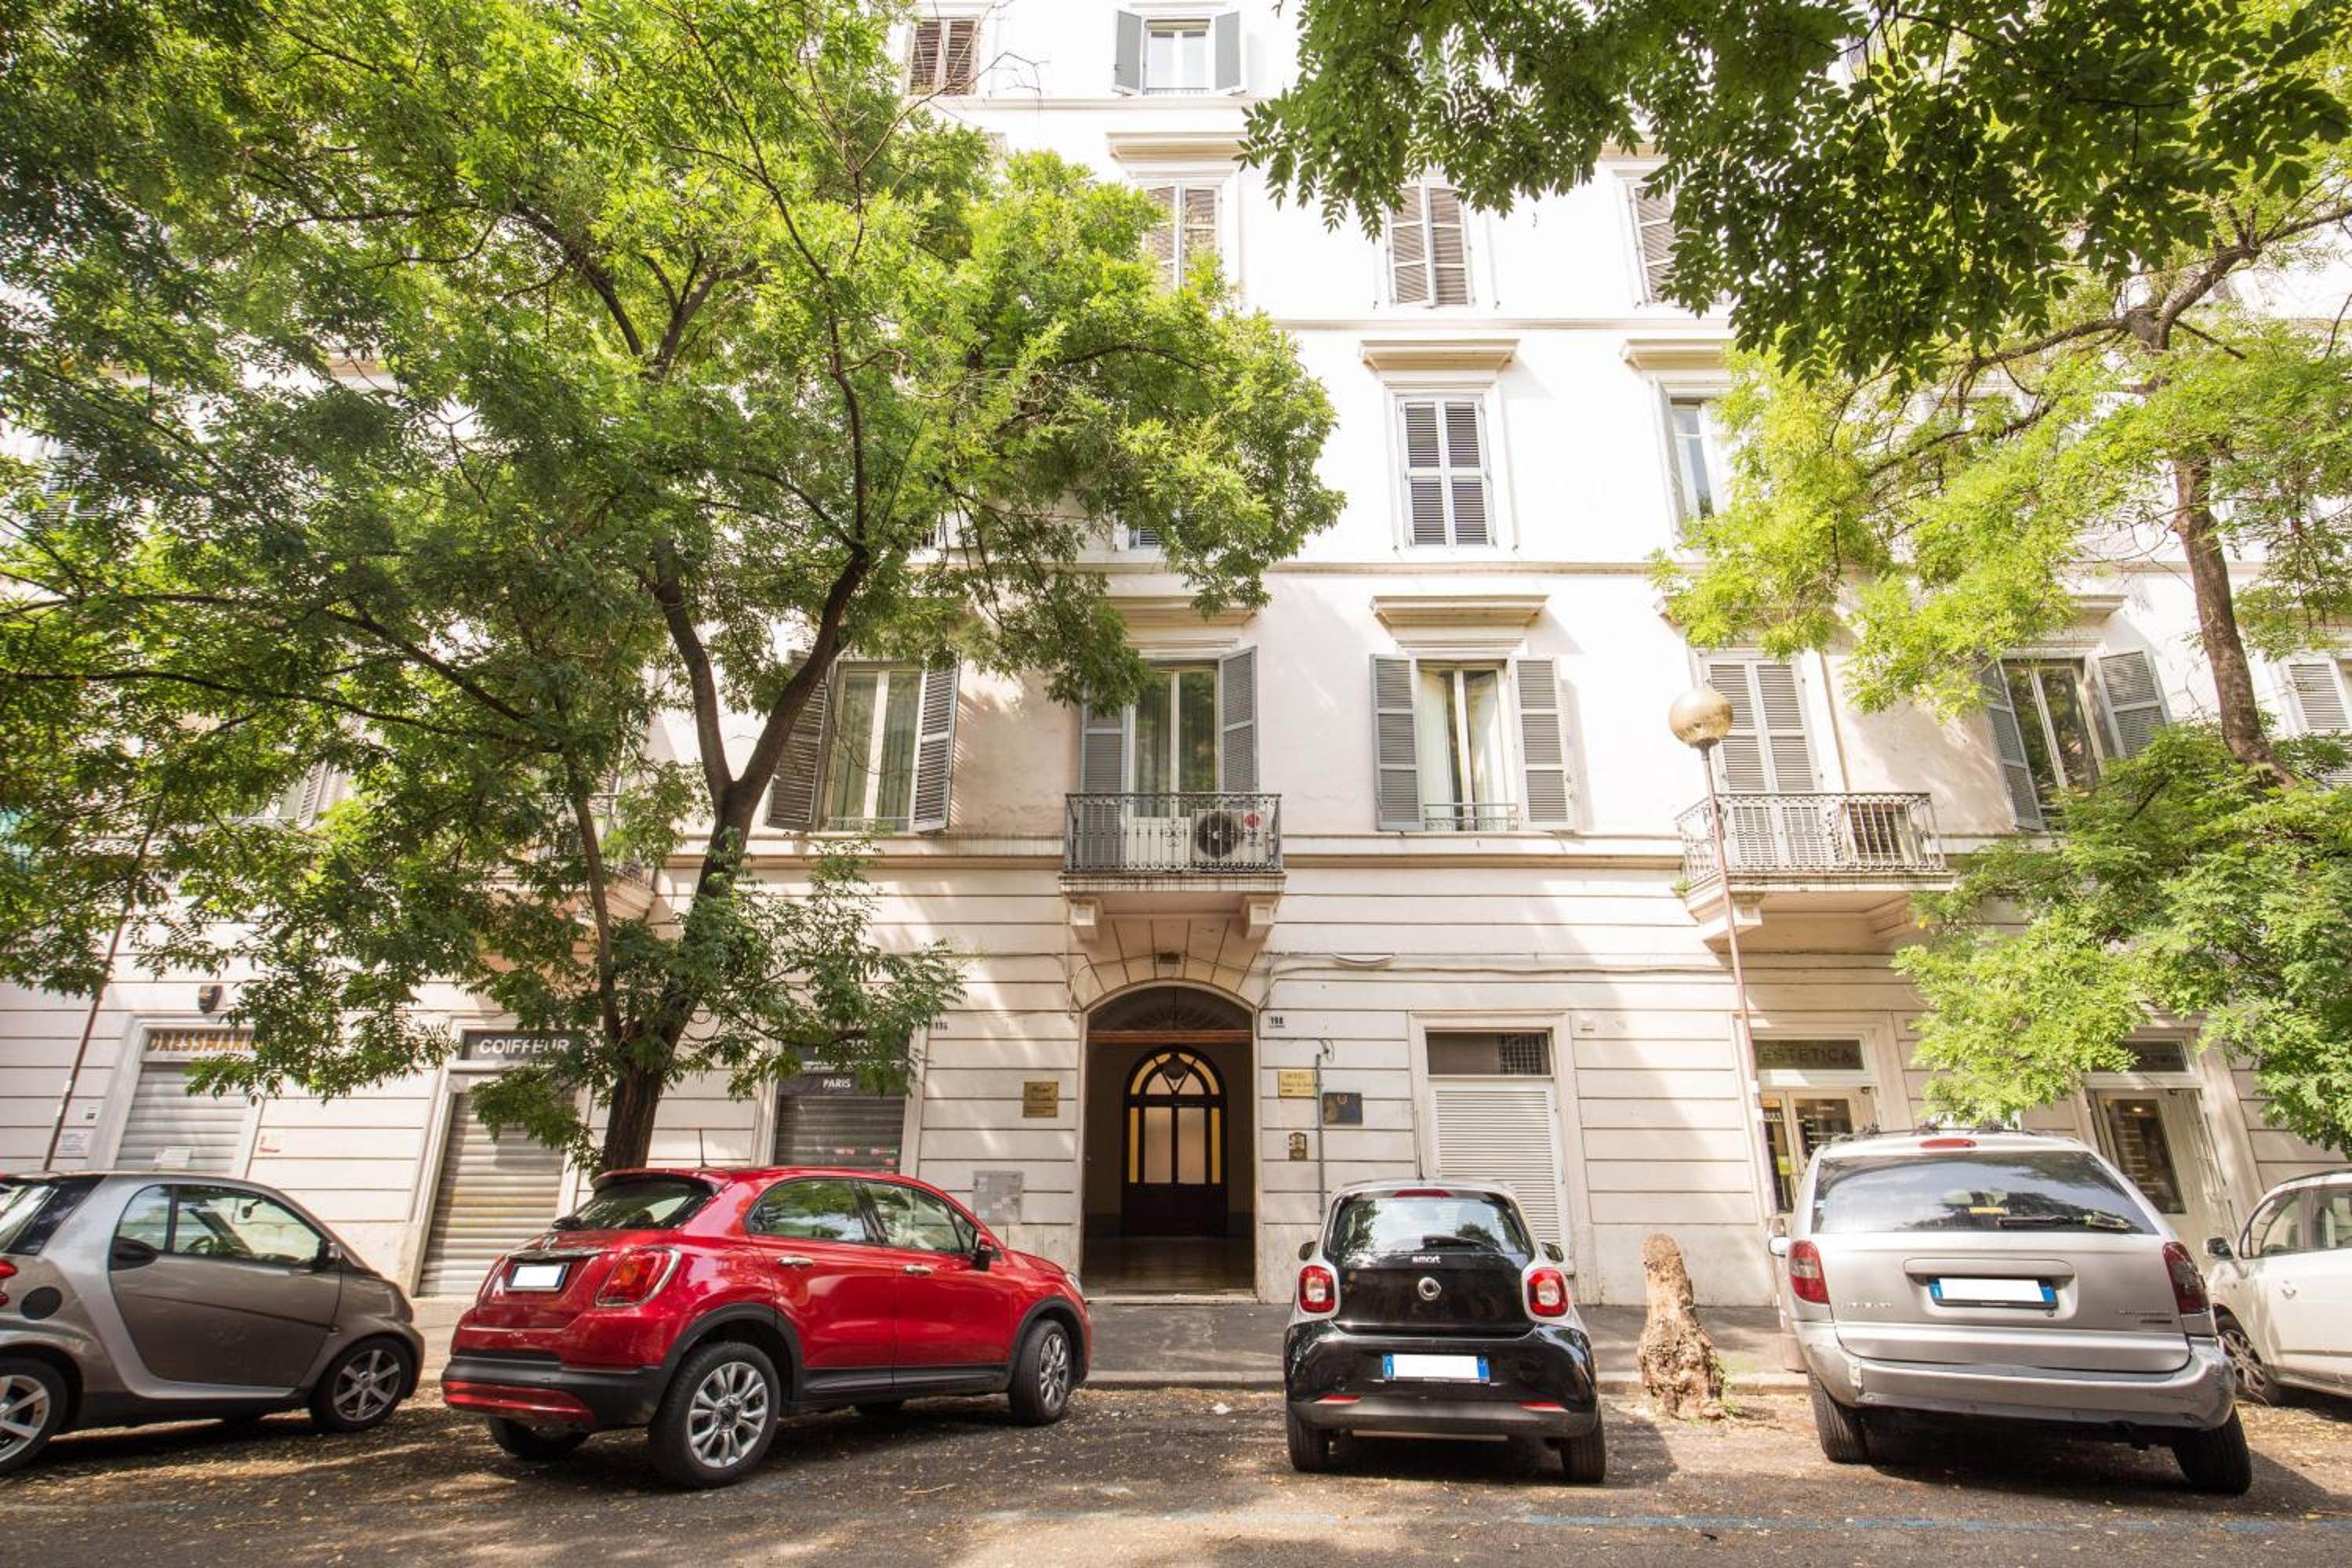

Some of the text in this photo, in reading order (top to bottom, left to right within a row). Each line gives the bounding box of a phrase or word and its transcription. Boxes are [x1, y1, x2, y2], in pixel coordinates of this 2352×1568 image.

[478, 1039, 570, 1054] COIFFEUR
[1762, 1048, 1853, 1062] ESTETICA
[822, 1078, 851, 1089] PARIS
[1412, 1254, 1441, 1264] smart
